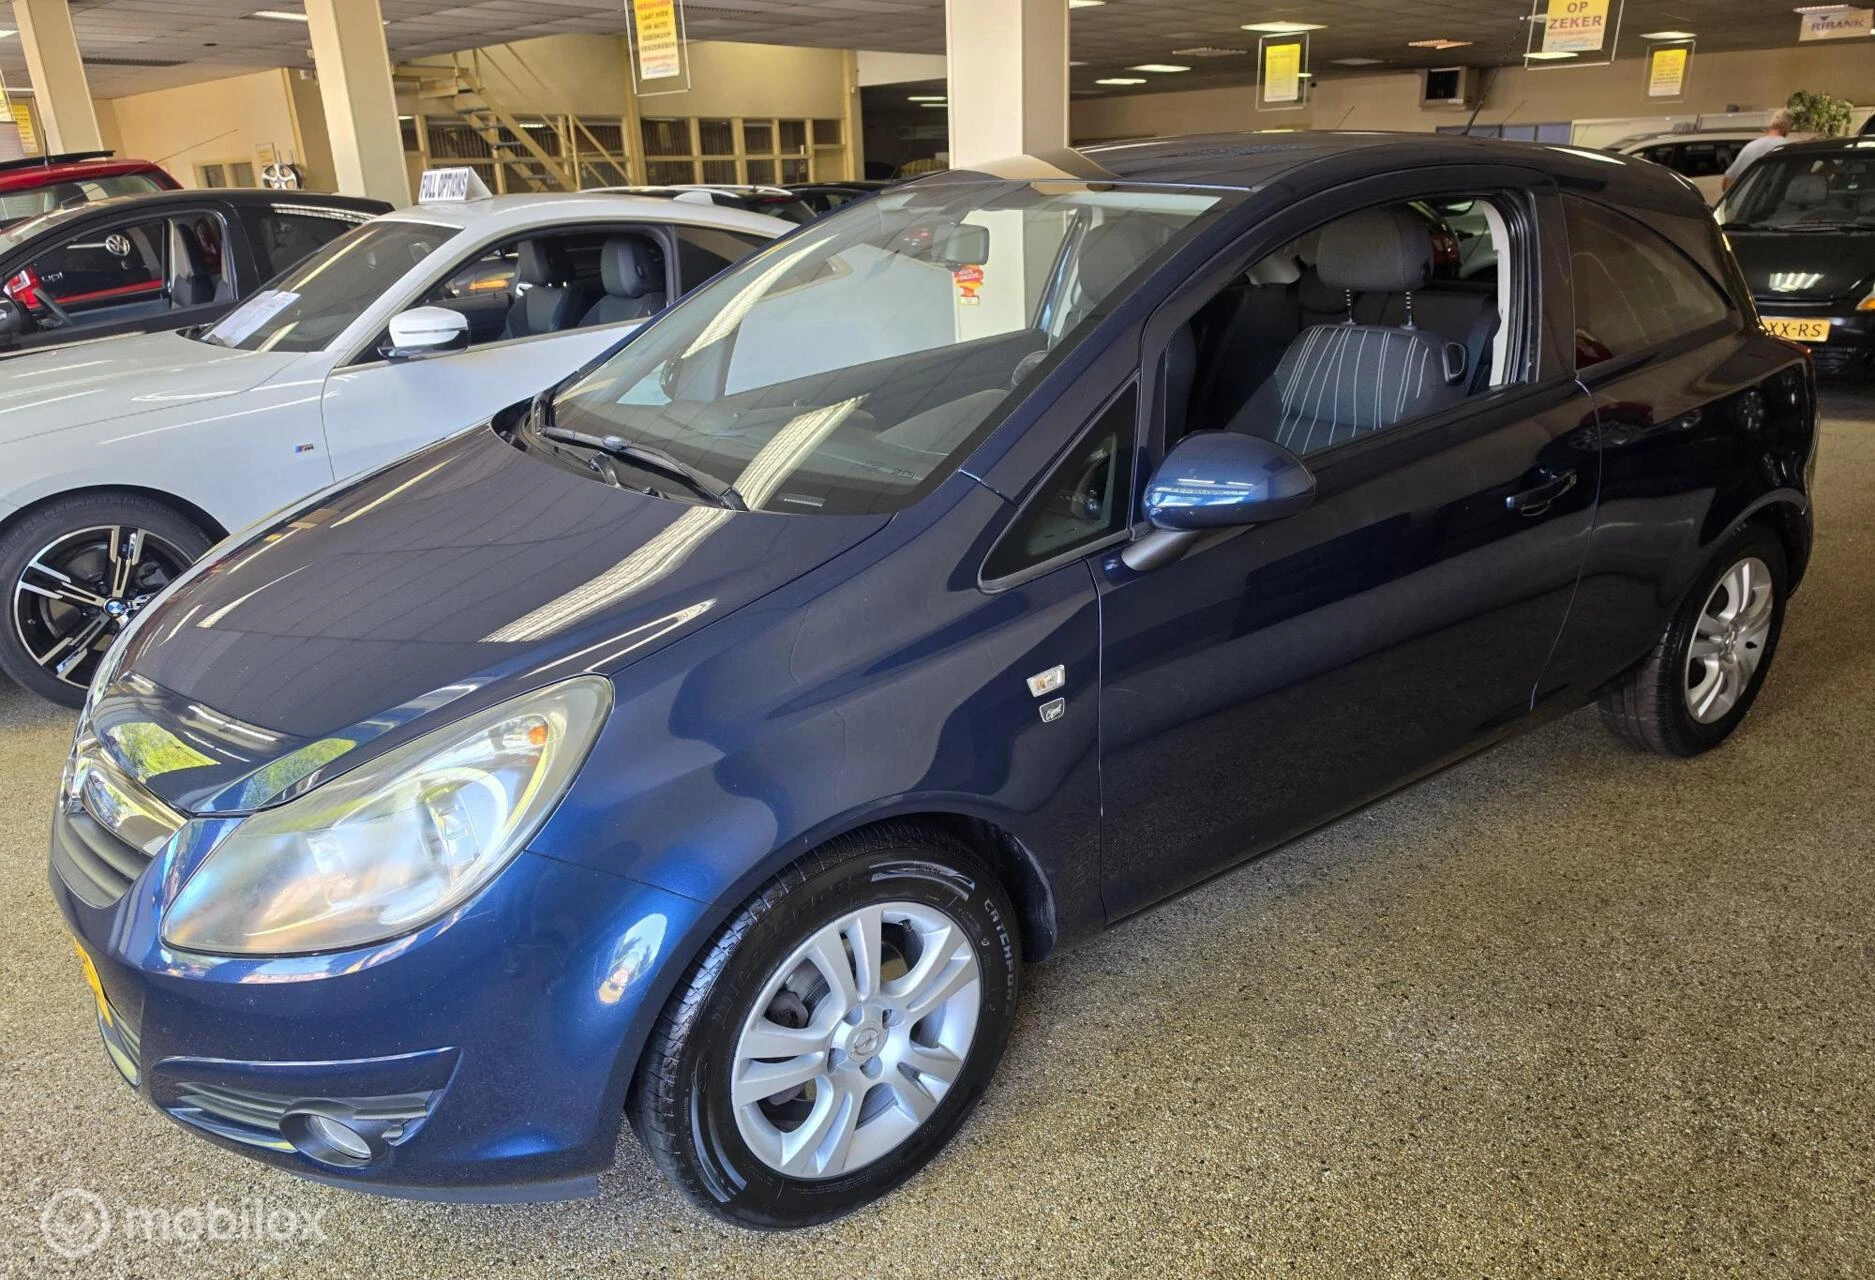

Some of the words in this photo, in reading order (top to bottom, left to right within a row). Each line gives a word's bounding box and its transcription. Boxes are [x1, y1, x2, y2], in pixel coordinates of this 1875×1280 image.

[1567, 2, 1588, 13] OP
[640, 12, 654, 20] LAAT
[655, 10, 669, 18] HIER
[653, 21, 668, 29] AUTO
[1549, 16, 1602, 29] ZEKER
[420, 173, 436, 199] FULL
[437, 170, 467, 198] OPTIONS
